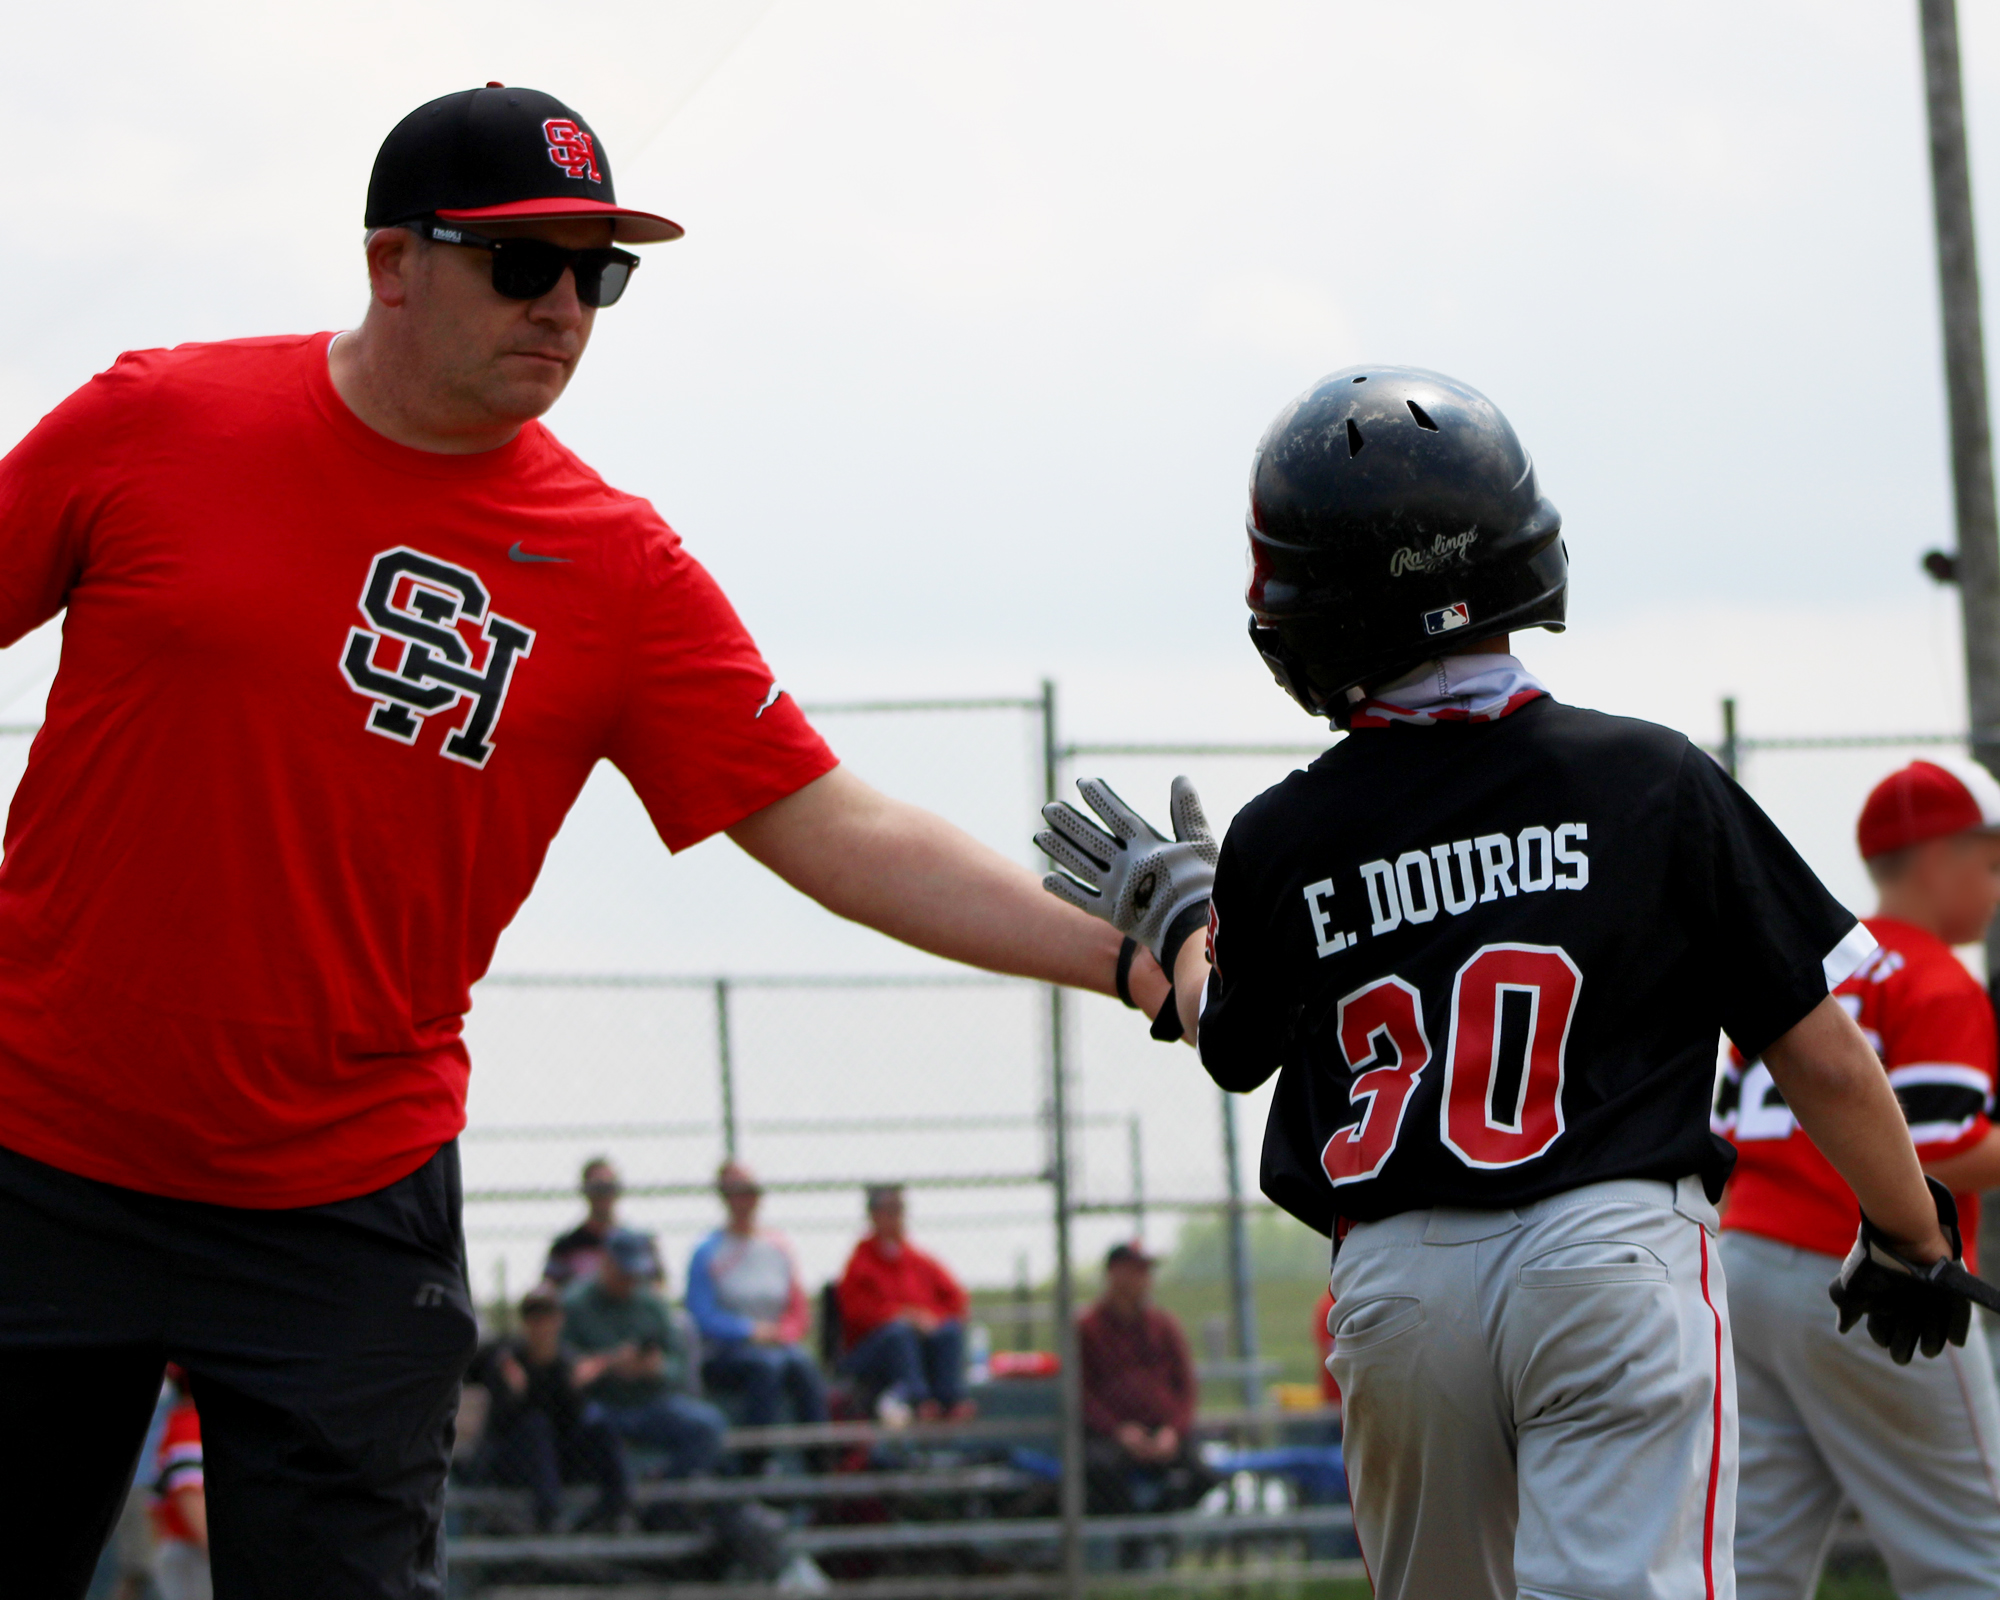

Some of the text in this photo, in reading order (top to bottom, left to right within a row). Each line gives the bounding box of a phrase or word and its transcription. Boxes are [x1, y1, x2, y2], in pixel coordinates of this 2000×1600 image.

[1303, 877, 1358, 958] E.
[1359, 823, 1589, 936] DOUROS
[1321, 942, 1583, 1188] 30
